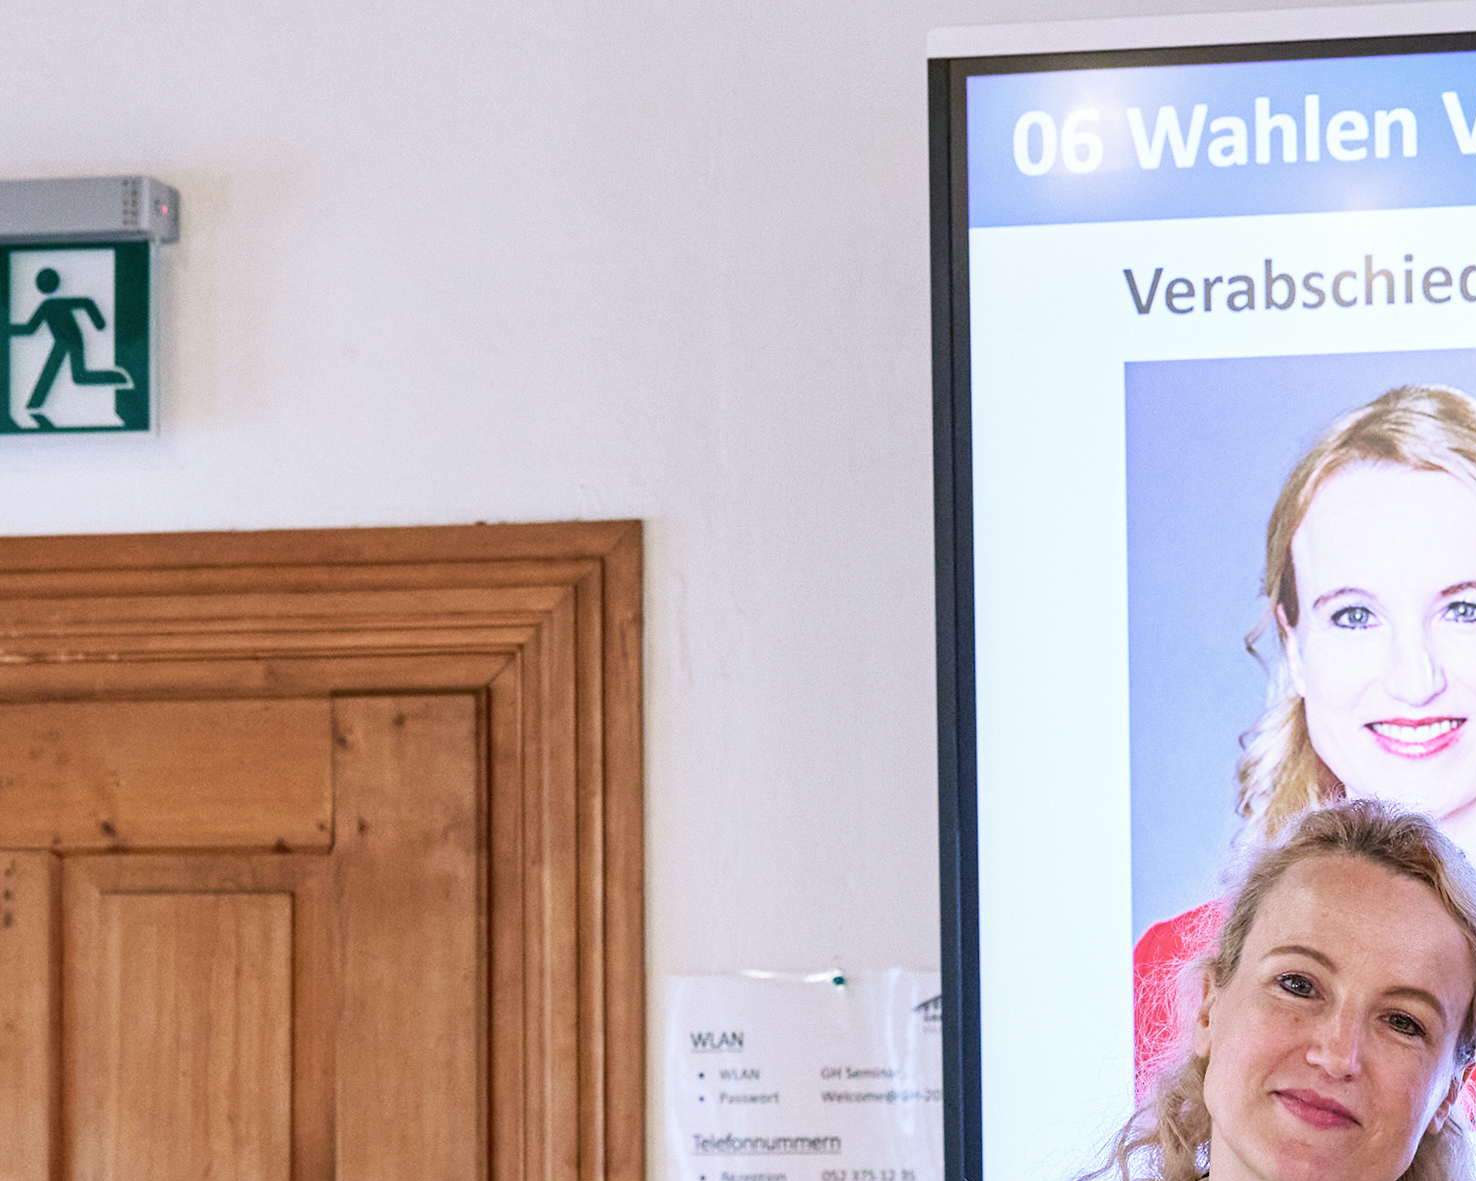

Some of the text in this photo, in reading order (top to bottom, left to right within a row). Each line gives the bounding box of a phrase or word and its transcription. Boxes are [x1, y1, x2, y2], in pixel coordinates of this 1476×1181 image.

[1011, 108, 1105, 177] 06
[1126, 93, 1419, 170] Wahlen
[690, 1031, 745, 1050] WLAN
[692, 1132, 842, 1153] Telefonnummern
